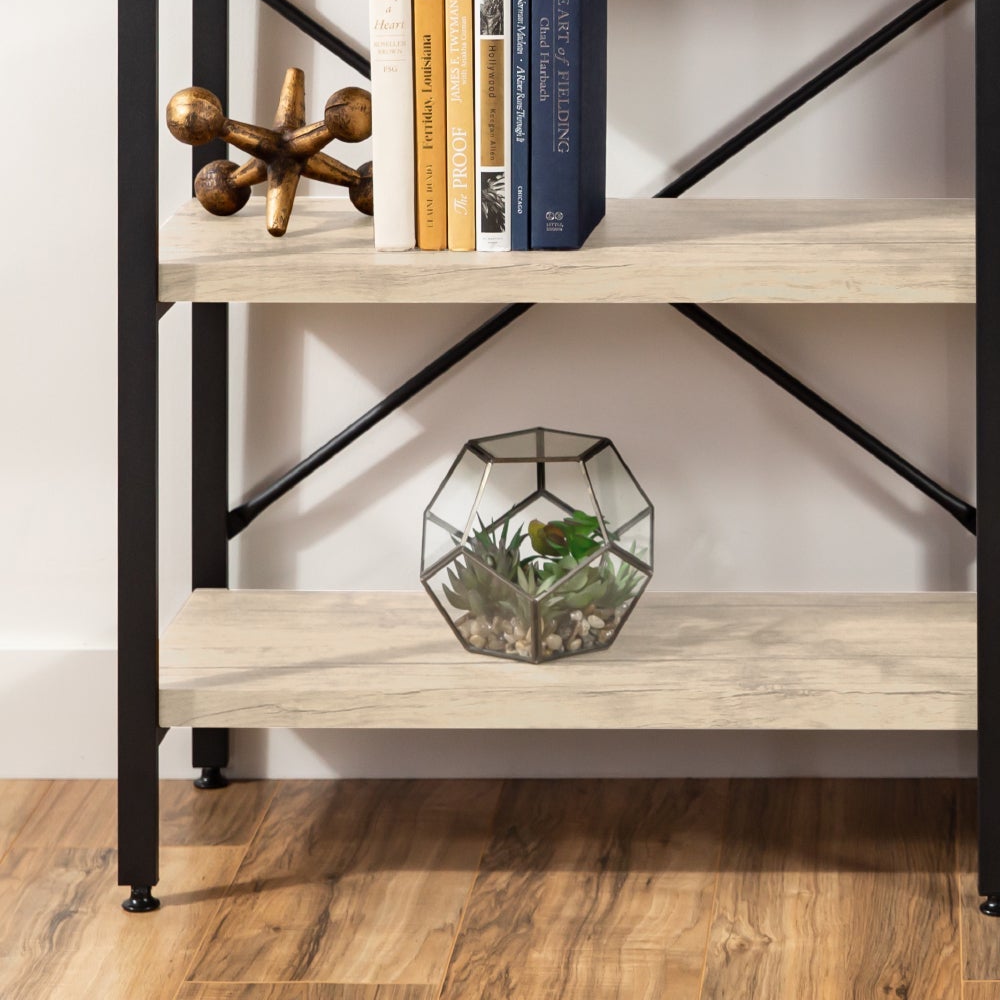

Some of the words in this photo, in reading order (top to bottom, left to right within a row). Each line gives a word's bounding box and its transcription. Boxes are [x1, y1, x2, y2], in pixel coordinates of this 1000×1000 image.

[374, 19, 405, 31] Heart
[449, 0, 460, 53] TWYMAN
[539, 17, 550, 51] Chad
[557, 9, 570, 44] ART
[421, 34, 434, 93] Louisiana
[487, 44, 497, 99] Hollywood
[539, 53, 549, 102] Harbach
[554, 47, 569, 67] of
[450, 68, 462, 103] JAMES
[421, 96, 434, 150] Ferriday,
[557, 70, 570, 154] FIELDING
[452, 127, 468, 189] PROOF
[452, 193, 469, 216] The
